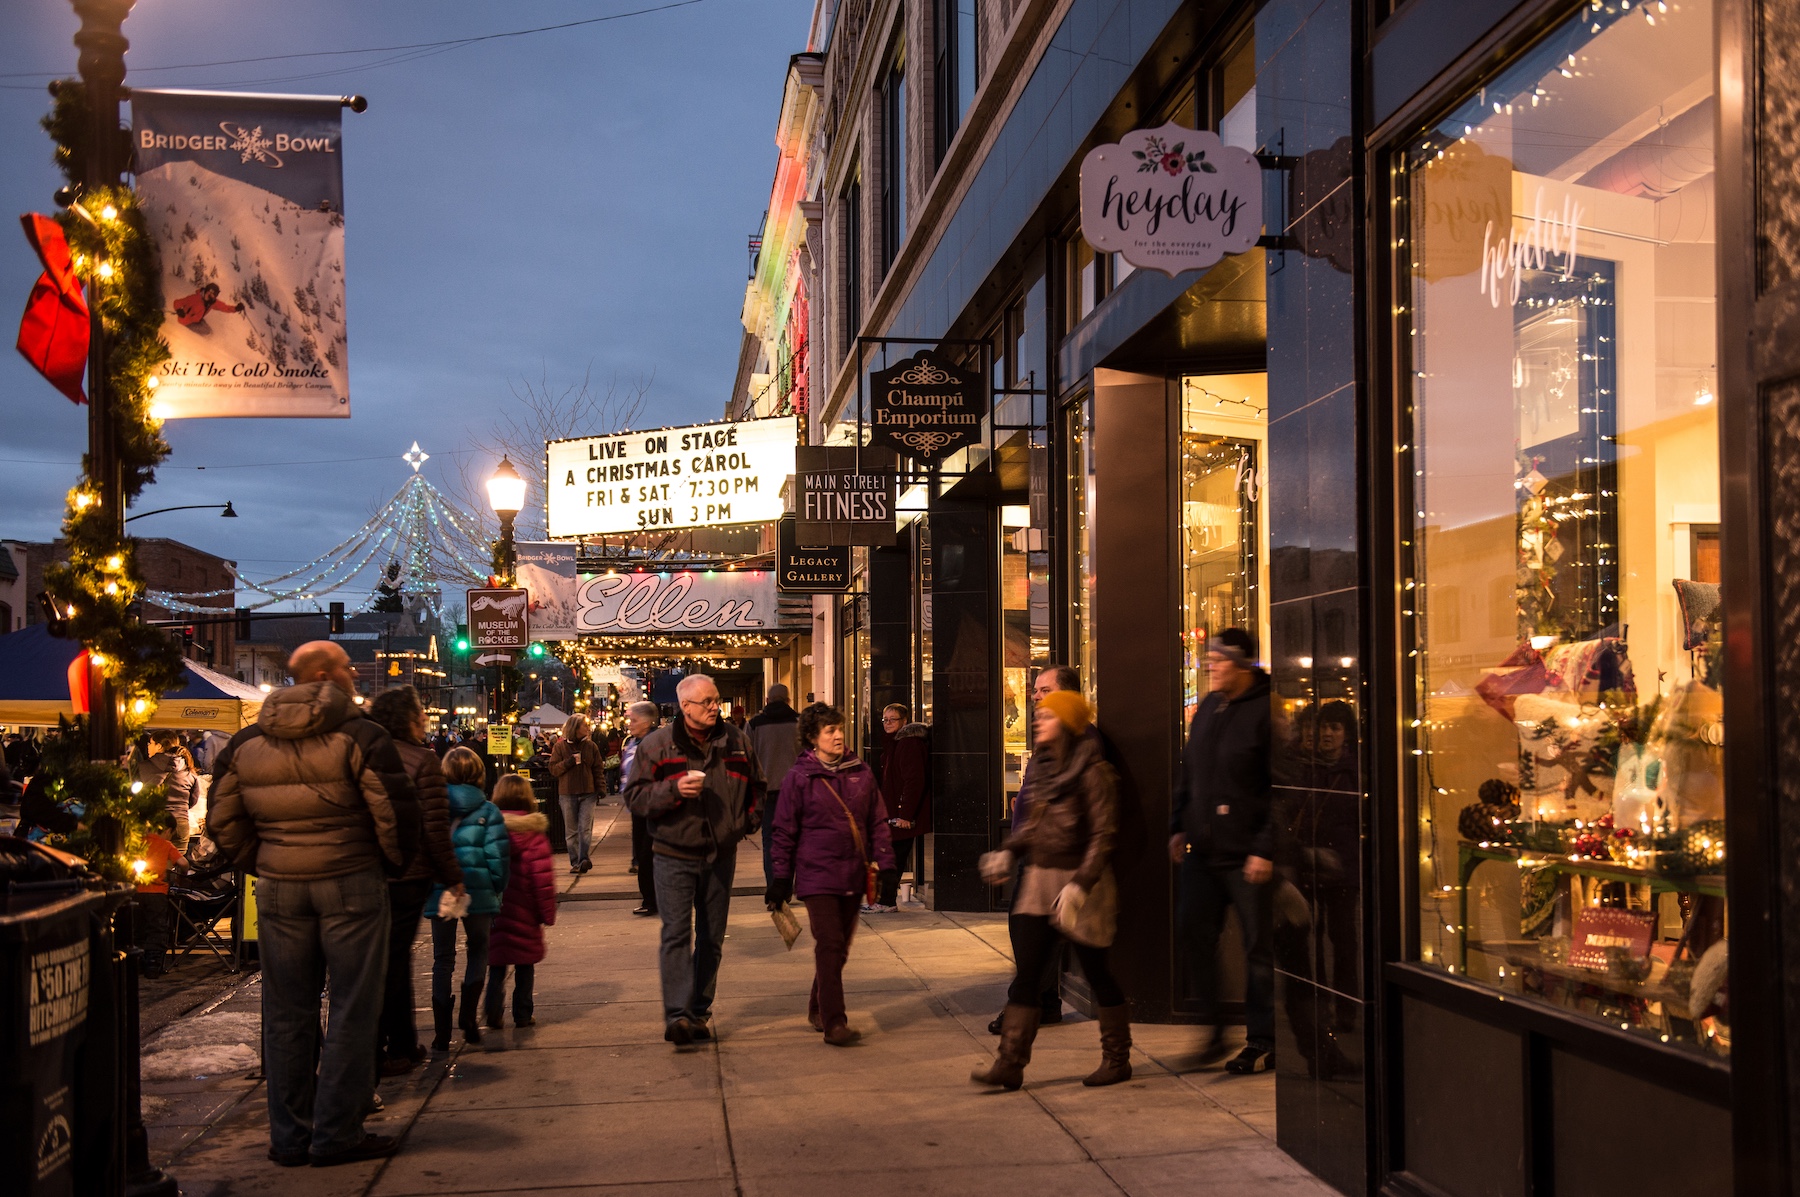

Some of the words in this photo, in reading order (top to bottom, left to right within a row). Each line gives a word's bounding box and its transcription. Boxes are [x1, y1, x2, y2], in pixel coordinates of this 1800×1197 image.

[140, 129, 227, 151] BRIDGER
[276, 132, 335, 153] BOWL
[1102, 174, 1247, 237] heyday
[1134, 240, 1148, 248] for
[1152, 240, 1167, 248] the
[1170, 240, 1212, 249] everyday
[1146, 248, 1200, 256] celebration
[1481, 185, 1585, 308] heyday
[159, 361, 189, 377] Ski
[195, 361, 226, 378] The
[231, 361, 270, 378] Cold
[273, 363, 329, 379] Smoke
[213, 382, 232, 390] away
[243, 381, 276, 390] Beautiful
[277, 381, 303, 390] Bridger
[305, 382, 333, 391] Canyon
[876, 408, 978, 429] Emporium
[589, 441, 627, 461] LIVE
[644, 436, 668, 455] ON
[681, 428, 738, 451] STAGE
[565, 469, 576, 486] A
[586, 459, 682, 485] CHRISTMAS
[691, 452, 751, 474] CAROL
[805, 474, 837, 490] MAIN
[843, 474, 887, 490] STREET
[587, 490, 613, 507] FRI
[620, 488, 631, 504] &
[638, 484, 670, 503] SAT
[637, 507, 674, 527] SUN
[690, 505, 699, 522] 3
[707, 503, 731, 521] PM
[804, 491, 888, 520] FITNESS
[556, 554, 575, 562] BOWL
[789, 555, 839, 567] LEGACY
[786, 570, 843, 582] GALLERY
[576, 573, 764, 630] Ellen
[478, 620, 519, 630] MUSEUM
[478, 635, 519, 645] ROCKIES
